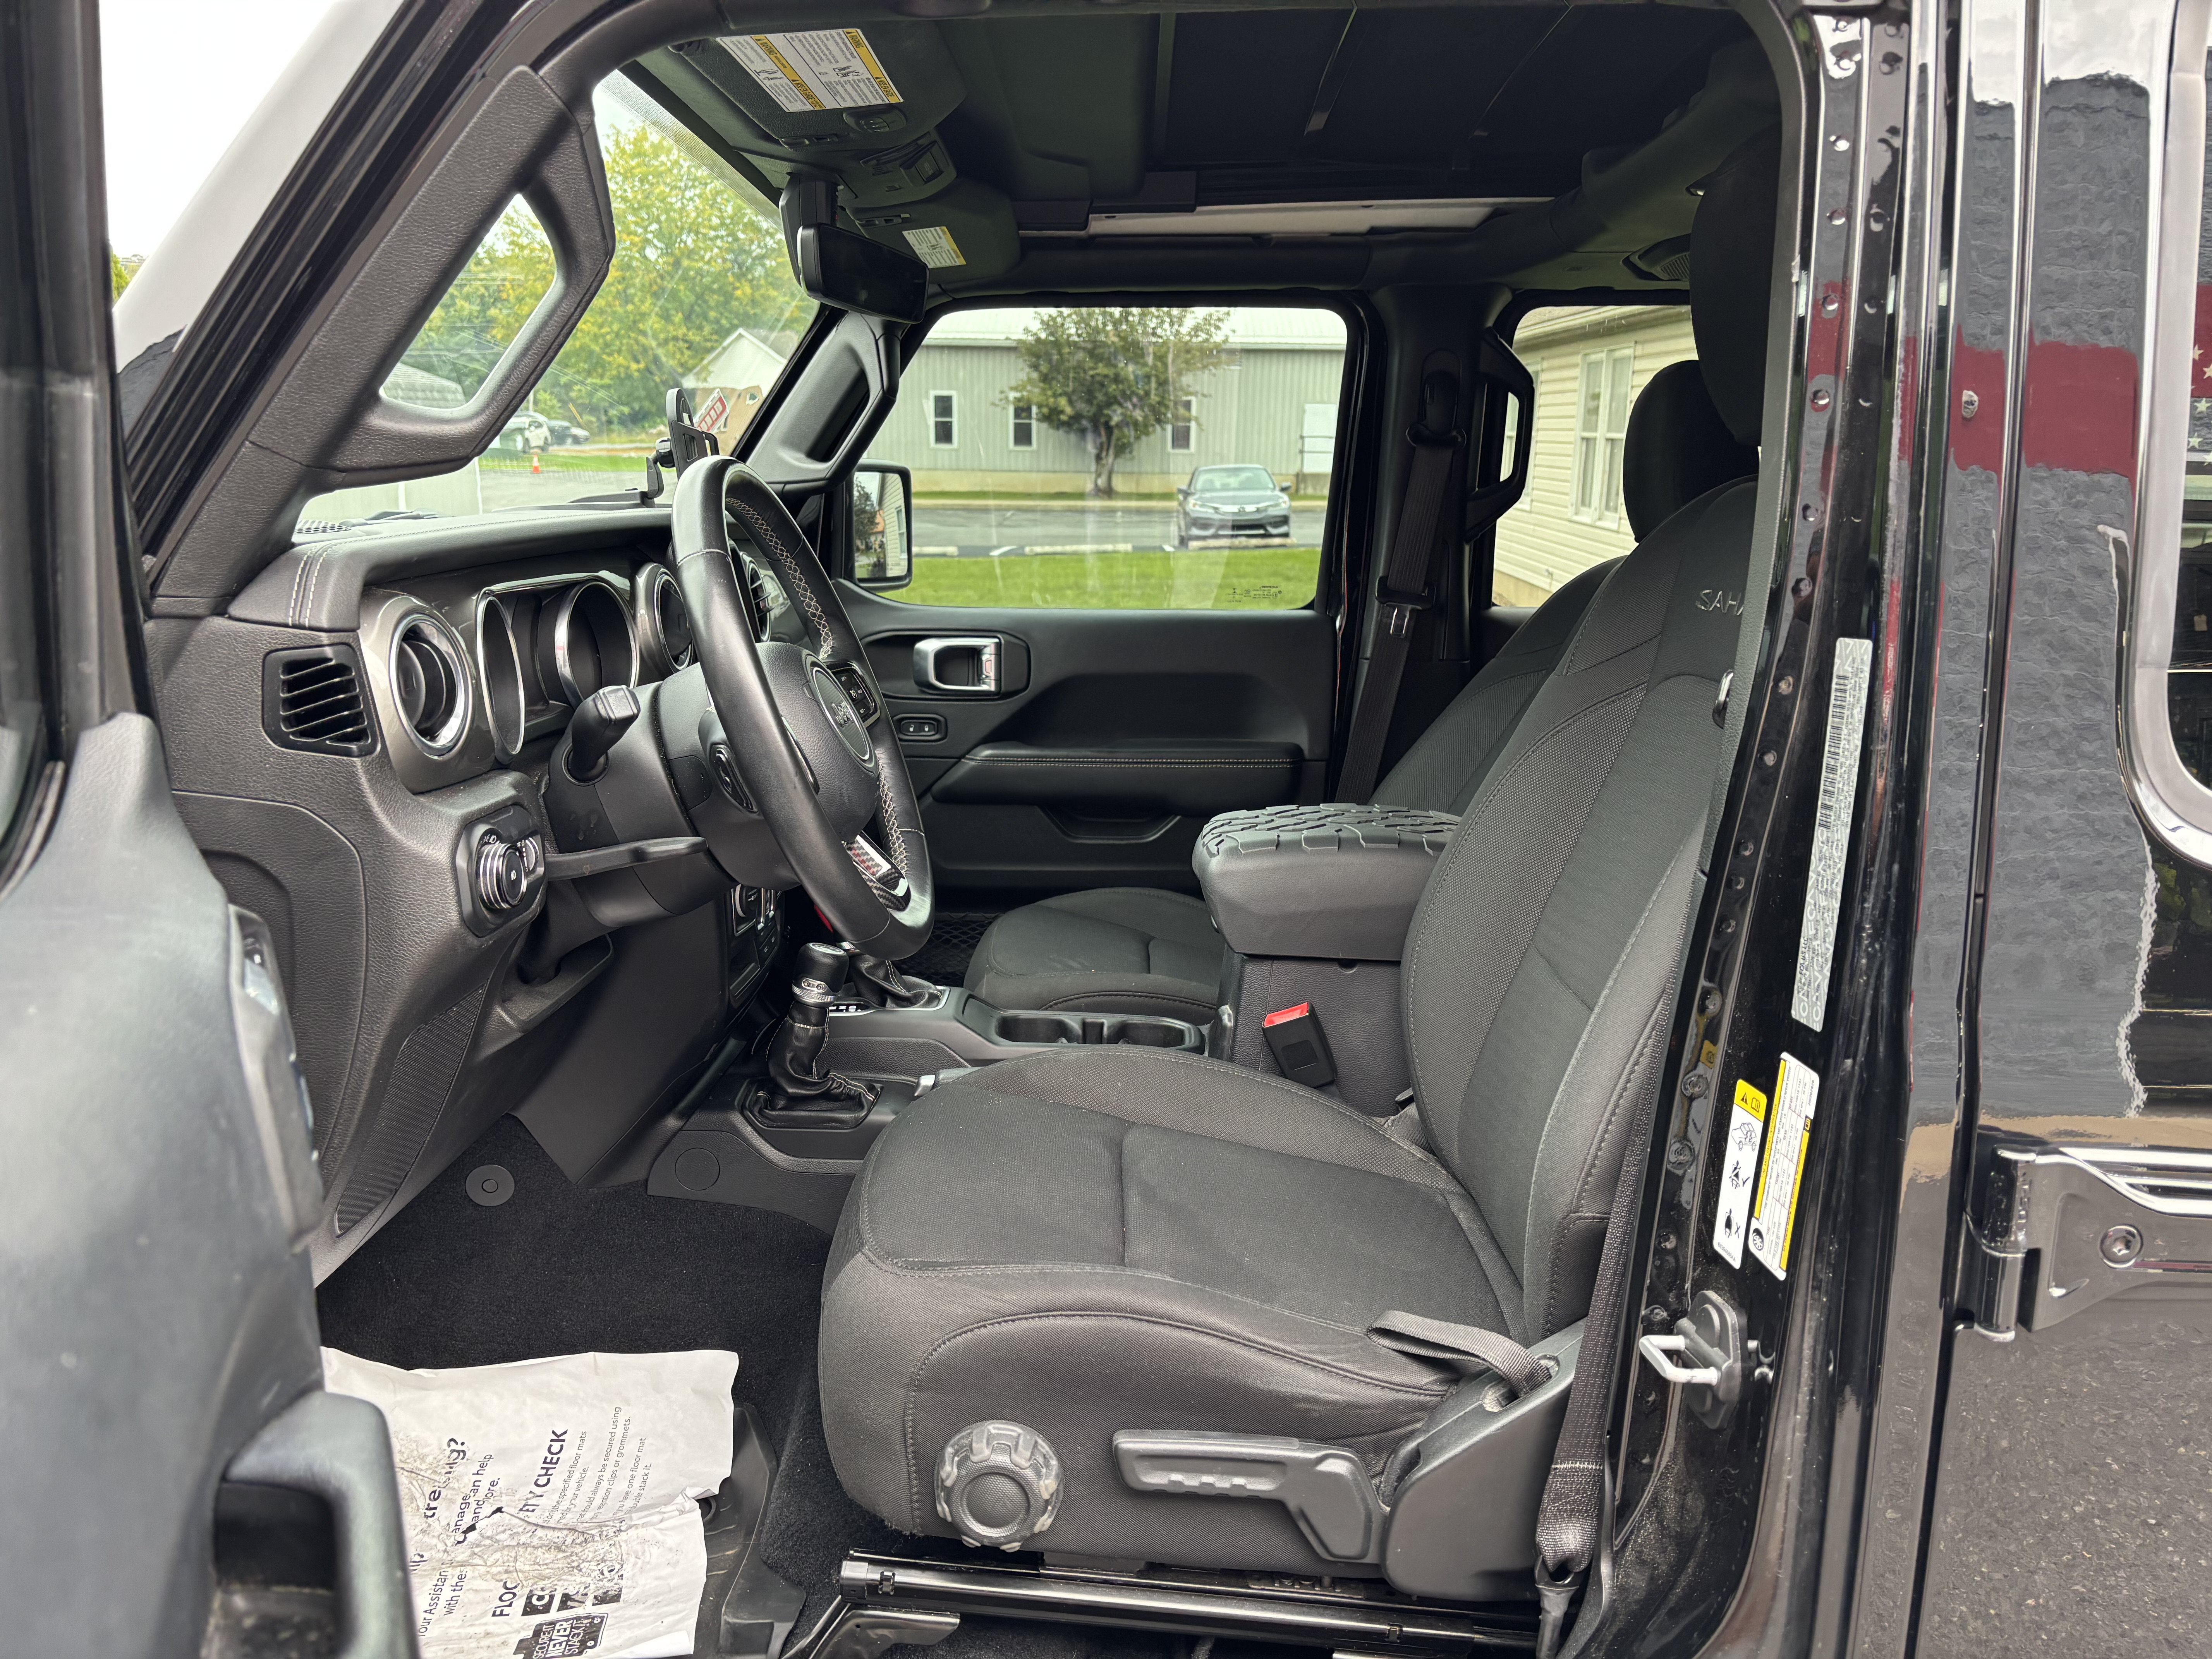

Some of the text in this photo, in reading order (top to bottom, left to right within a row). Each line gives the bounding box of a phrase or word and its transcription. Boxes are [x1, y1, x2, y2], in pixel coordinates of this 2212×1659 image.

[1801, 951, 1806, 961] US
[559, 1470, 574, 1499] specified
[569, 1453, 581, 1468] floor
[577, 1431, 587, 1450] mats
[591, 1475, 604, 1496] always
[598, 1464, 607, 1472] be
[604, 1432, 616, 1461] secured
[612, 1407, 622, 1429] using
[607, 1470, 617, 1486] clips
[617, 1417, 630, 1457] grommets.
[630, 1455, 641, 1472] floor
[519, 1491, 544, 1512] ETY
[534, 1430, 567, 1487] CHECK
[575, 1467, 589, 1491] vehicle.
[639, 1472, 649, 1491] stack
[424, 1568, 448, 1614] Assistan
[452, 1493, 471, 1533] anage
[472, 1455, 494, 1475] help
[444, 1595, 460, 1615] with
[472, 1500, 485, 1522] and
[532, 1630, 552, 1659] SECURE
[545, 1620, 573, 1657] NEVER
[564, 1627, 585, 1655] STACK
